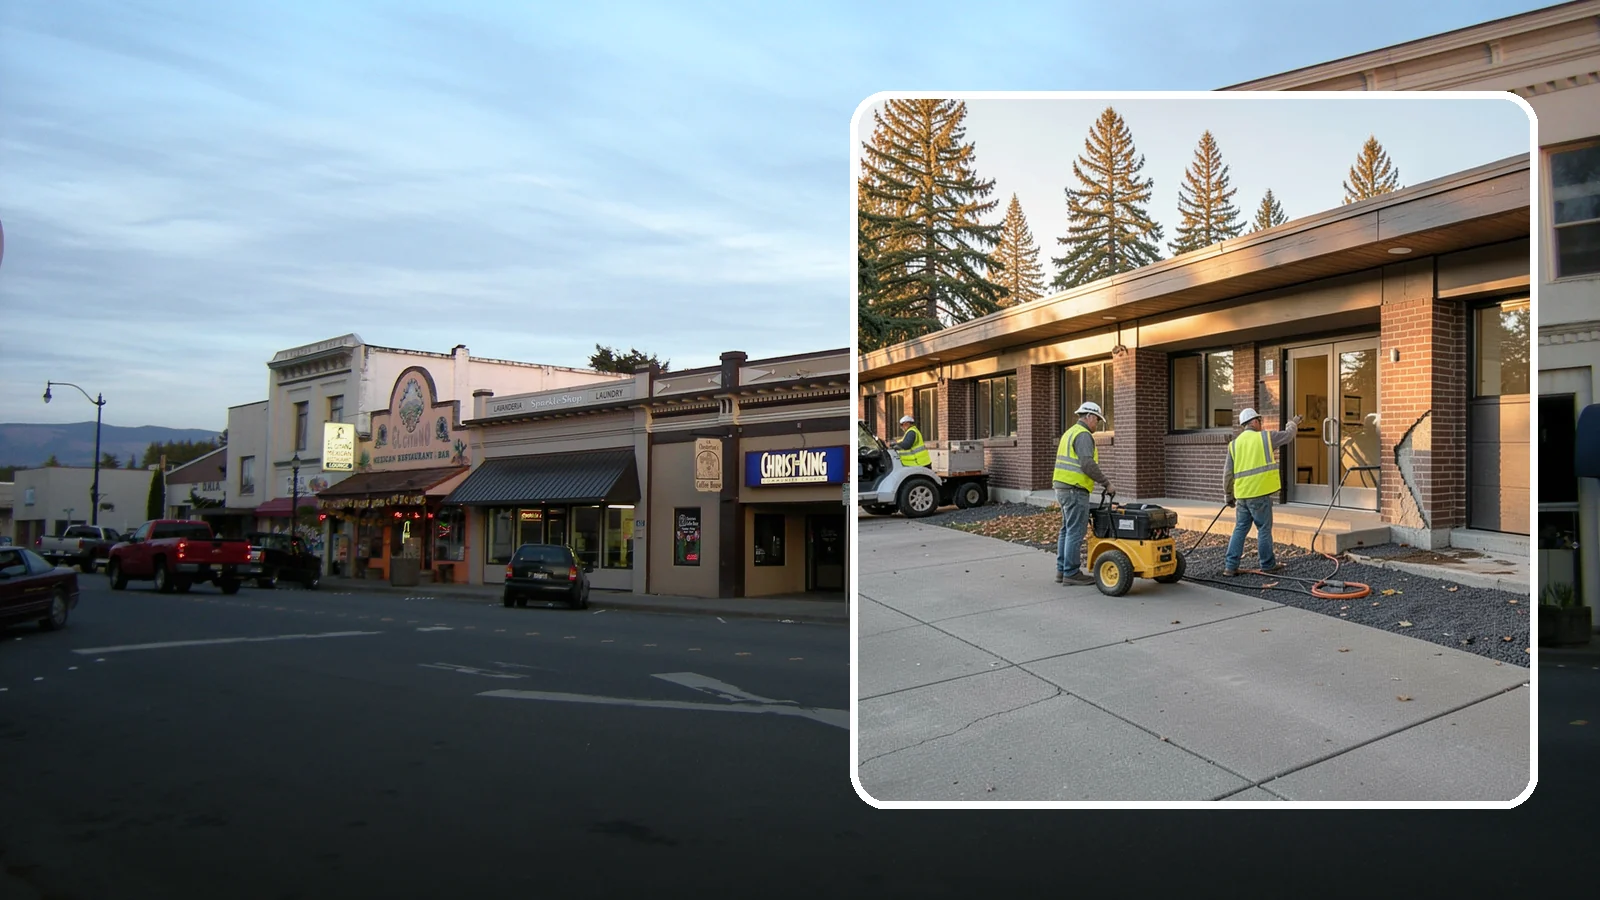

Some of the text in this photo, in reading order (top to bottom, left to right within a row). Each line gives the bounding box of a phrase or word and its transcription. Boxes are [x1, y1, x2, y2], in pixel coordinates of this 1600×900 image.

[531, 394, 583, 409] Sparkle Shop
[595, 389, 624, 400] LAUNDRY
[493, 402, 522, 413] LAVANDERIA
[391, 425, 401, 449] EL
[374, 455, 396, 464] MEXICAN
[397, 452, 433, 462] RESTAURANT
[437, 450, 450, 459] BAR
[761, 449, 827, 478] CHRIST KING
[697, 480, 709, 488] Coffee
